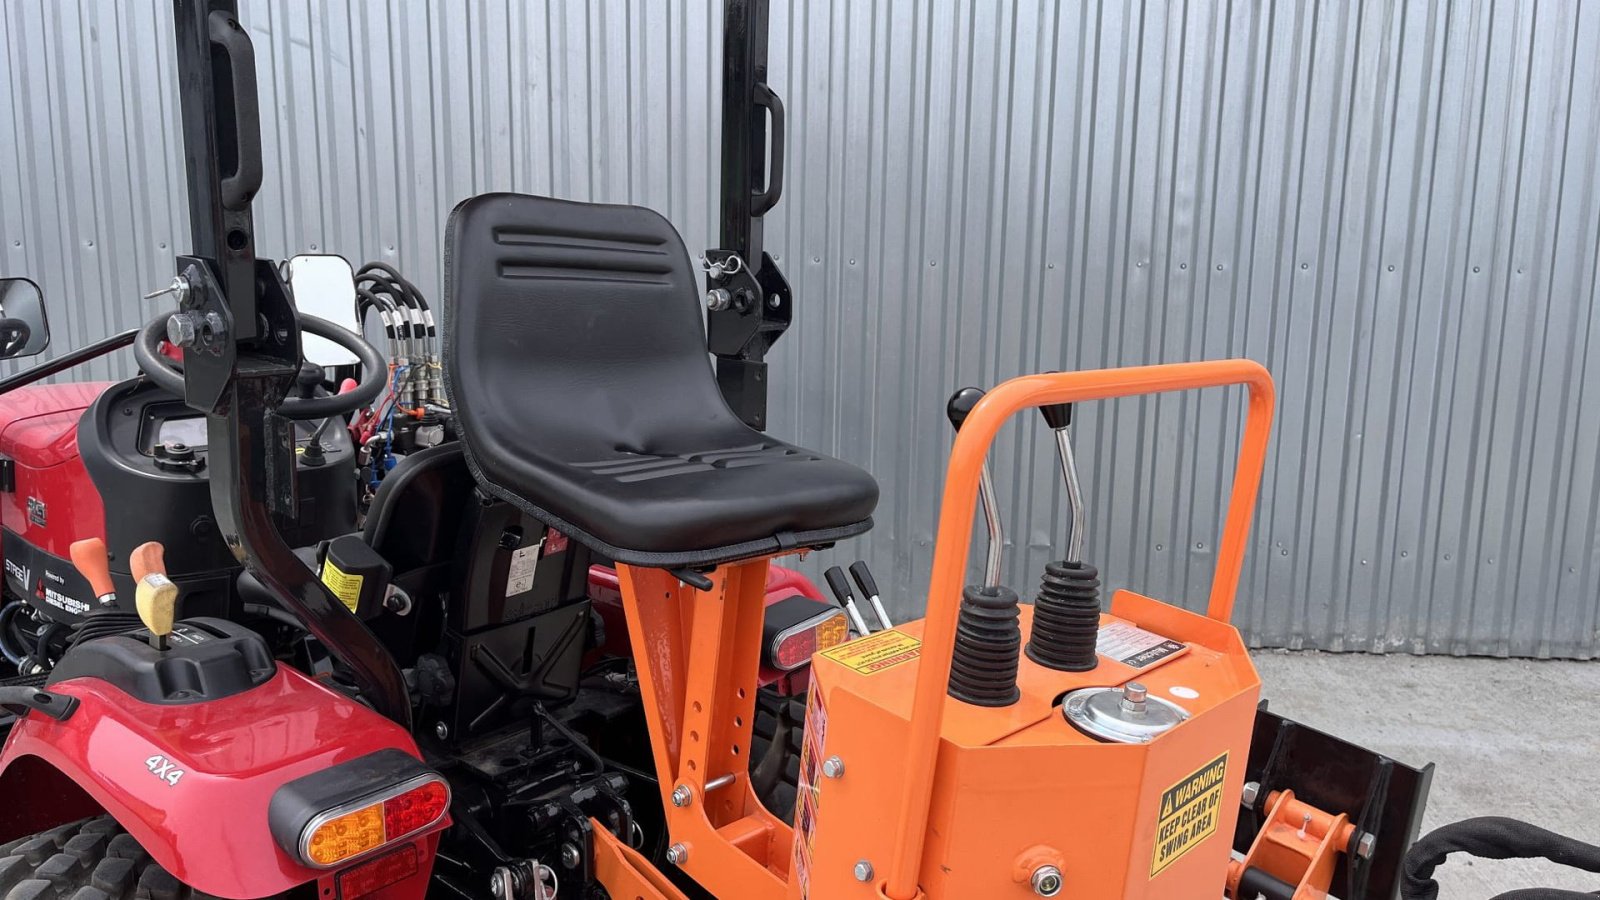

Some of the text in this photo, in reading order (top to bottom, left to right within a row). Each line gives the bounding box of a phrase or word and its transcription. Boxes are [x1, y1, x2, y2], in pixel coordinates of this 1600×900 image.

[45, 587, 90, 612] MITSUBISHI
[45, 597, 65, 610] DIESEL
[144, 754, 185, 787] 4X4
[1175, 761, 1224, 808] WARNING
[1159, 788, 1220, 844] KEEP CLEAR OF
[1160, 812, 1212, 862] SWING AREA
